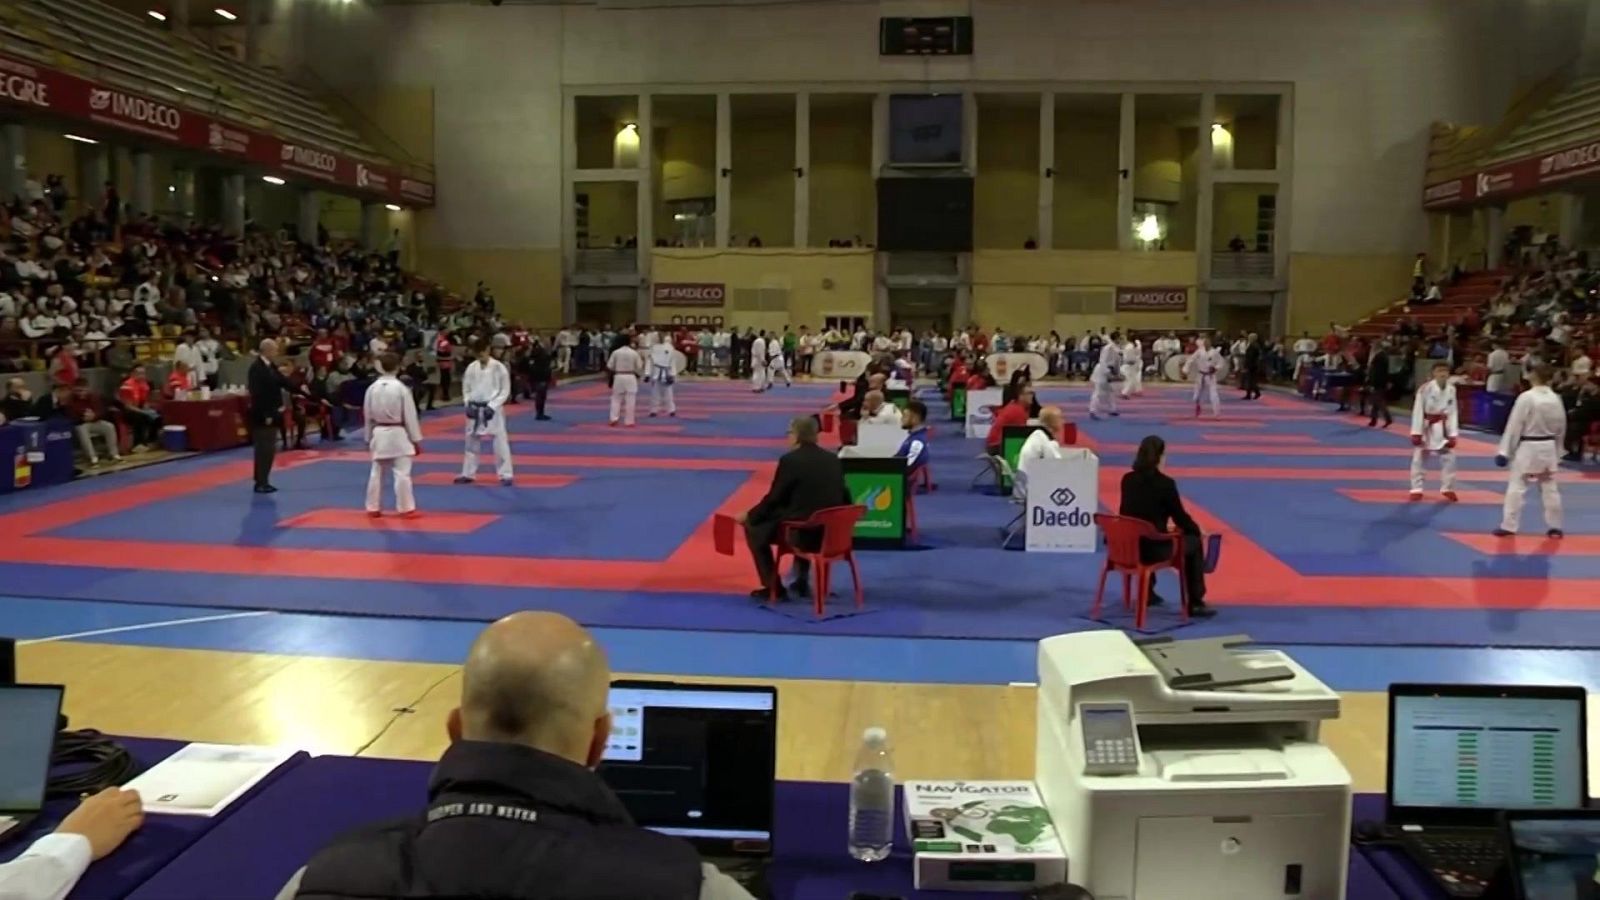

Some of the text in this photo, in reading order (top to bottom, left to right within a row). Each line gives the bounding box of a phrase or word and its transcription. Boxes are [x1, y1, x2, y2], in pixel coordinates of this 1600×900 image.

[112, 92, 180, 130] IMDECO
[294, 147, 336, 172] IMDECO
[1553, 143, 1600, 170] IMDEC
[1032, 505, 1091, 528] Daedo
[915, 783, 1030, 794] NAVIGATOR
